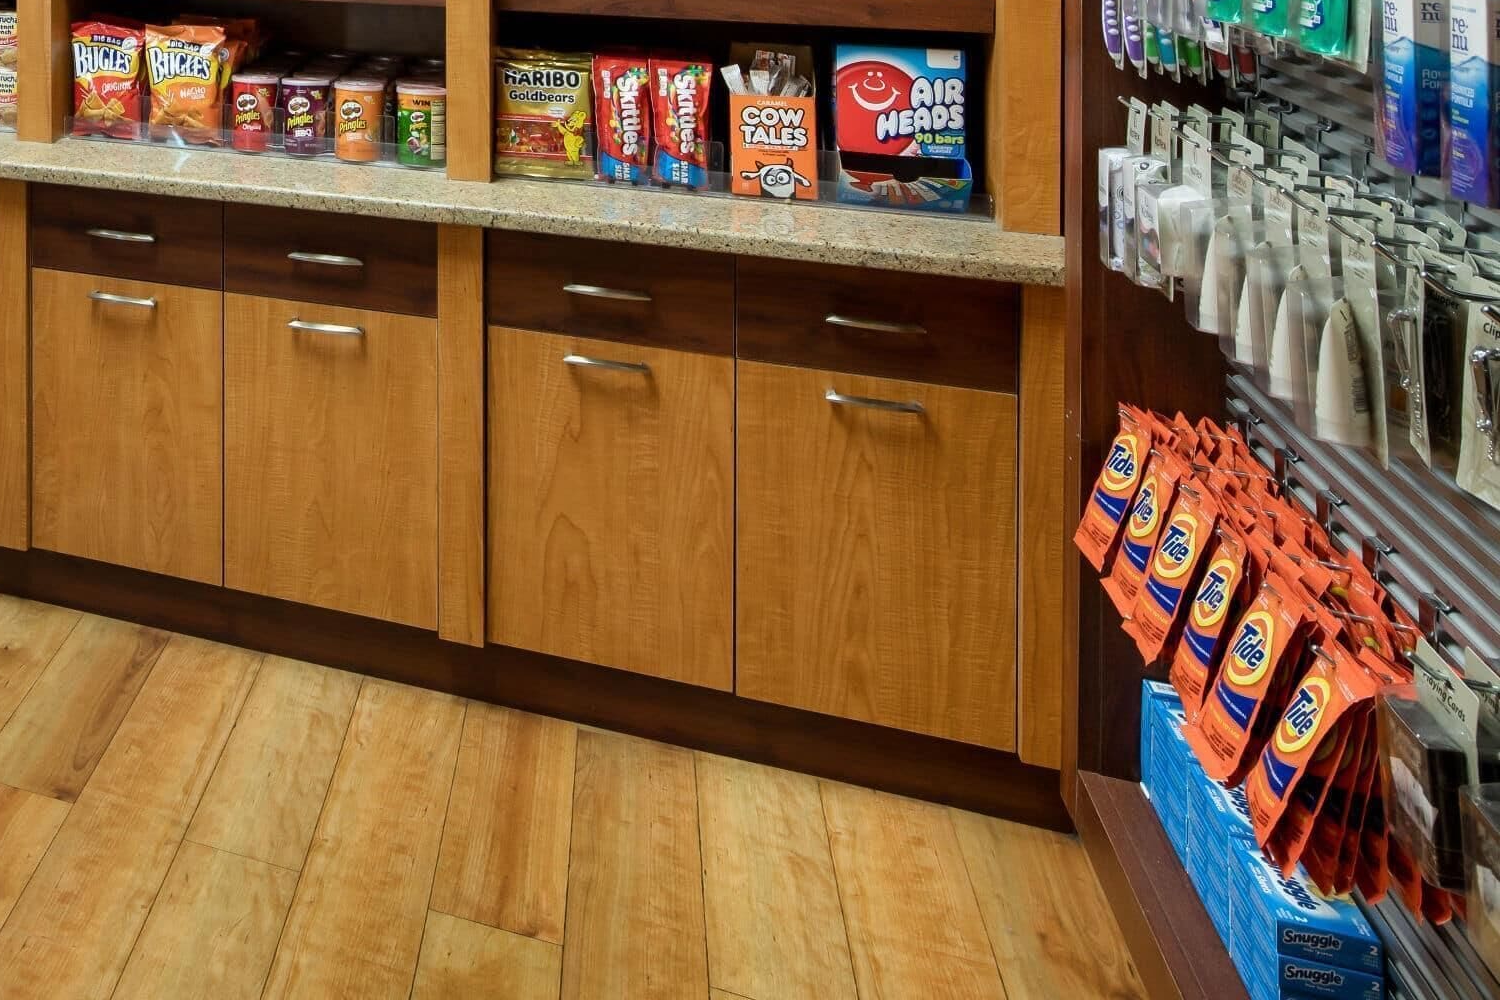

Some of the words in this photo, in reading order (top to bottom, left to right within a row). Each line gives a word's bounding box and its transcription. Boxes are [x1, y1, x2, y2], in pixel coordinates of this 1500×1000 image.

[1451, 35, 1468, 51] nu
[73, 41, 132, 78] BUGLES
[149, 46, 211, 85] BUGLES
[504, 69, 580, 88] HARIBO
[509, 90, 575, 103] Goldbears
[911, 78, 965, 108] AIR
[235, 110, 261, 124] Pringles
[287, 113, 314, 128] Pringles
[616, 74, 640, 156] Skittles
[673, 73, 696, 154] Skittles
[741, 107, 804, 126] COW
[876, 104, 964, 141] HEADS
[294, 128, 312, 137] BBQ
[339, 119, 366, 133] Pringles
[740, 125, 808, 147] TALES
[915, 133, 932, 144] 90
[935, 132, 964, 145] bars
[672, 162, 680, 182] SIZE
[1106, 443, 1136, 479] Tide
[1161, 524, 1190, 563] Tide
[1231, 622, 1265, 669] Tide
[1283, 687, 1319, 737] Tide
[1447, 695, 1466, 723] Cards
[1283, 929, 1342, 950] Snuggle
[1285, 964, 1342, 986] Snuggle
